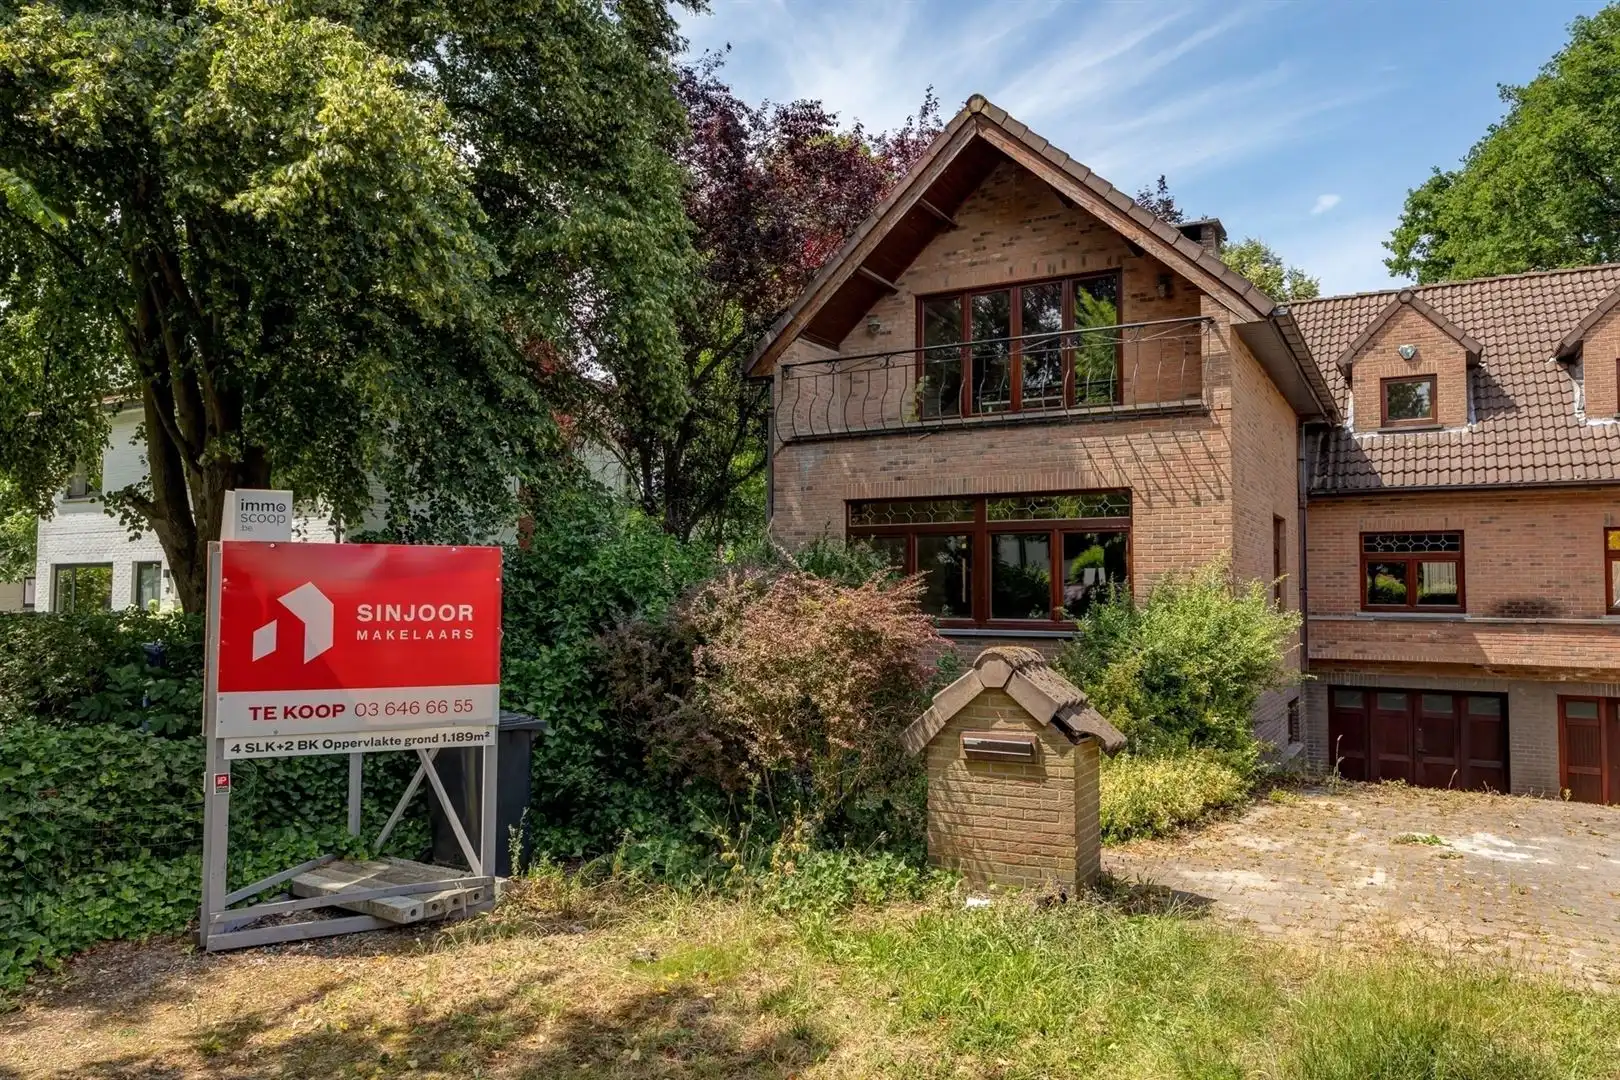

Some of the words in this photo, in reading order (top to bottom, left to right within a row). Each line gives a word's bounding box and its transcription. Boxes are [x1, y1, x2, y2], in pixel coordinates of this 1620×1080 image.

[241, 498, 286, 512] immo
[241, 513, 286, 527] scoop
[357, 604, 473, 622] SINJOOR
[356, 629, 473, 641] MAKELAARS
[248, 706, 277, 721] TE
[283, 704, 345, 720] KOOP
[354, 702, 379, 717] 03
[384, 701, 420, 716] 646
[425, 700, 448, 714] 66
[453, 699, 473, 713] 55
[230, 743, 241, 753] 4
[245, 741, 294, 754] SLK+2
[297, 740, 319, 750] BK
[322, 737, 401, 750] Oppervlakte
[404, 733, 439, 747] grond
